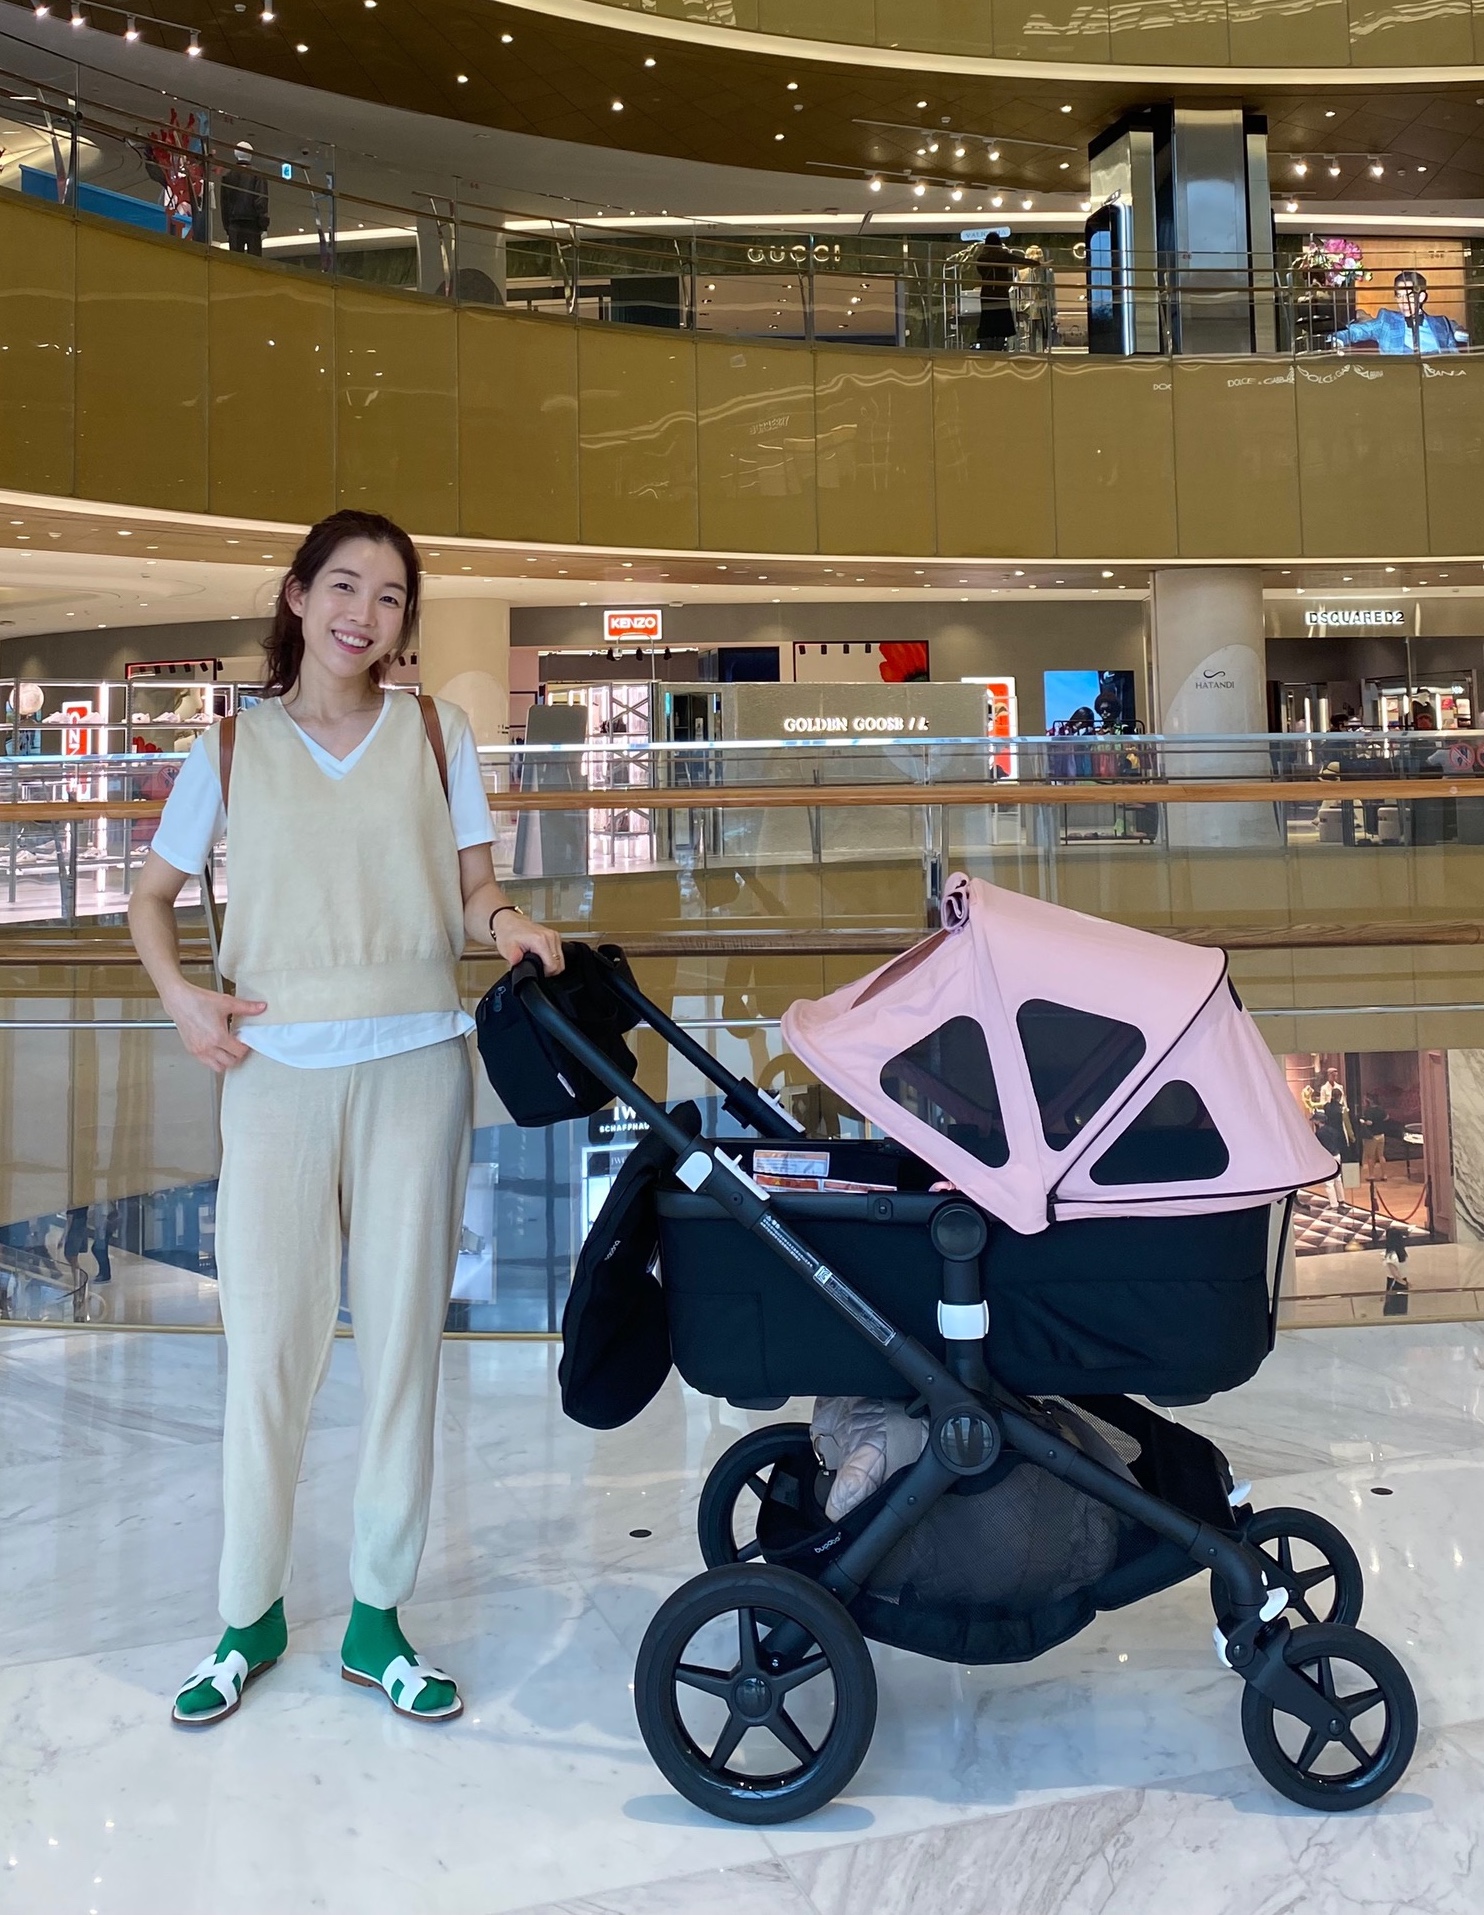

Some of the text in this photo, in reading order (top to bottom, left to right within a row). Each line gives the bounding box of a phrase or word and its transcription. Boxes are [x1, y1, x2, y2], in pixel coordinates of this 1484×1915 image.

[747, 245, 840, 262] GUCCI
[610, 616, 656, 629] KENZO
[1305, 610, 1405, 626] DSQUARED2
[1195, 681, 1235, 689] HATANDI
[783, 717, 848, 732] GOLDEN
[853, 717, 904, 731] GOOSE
